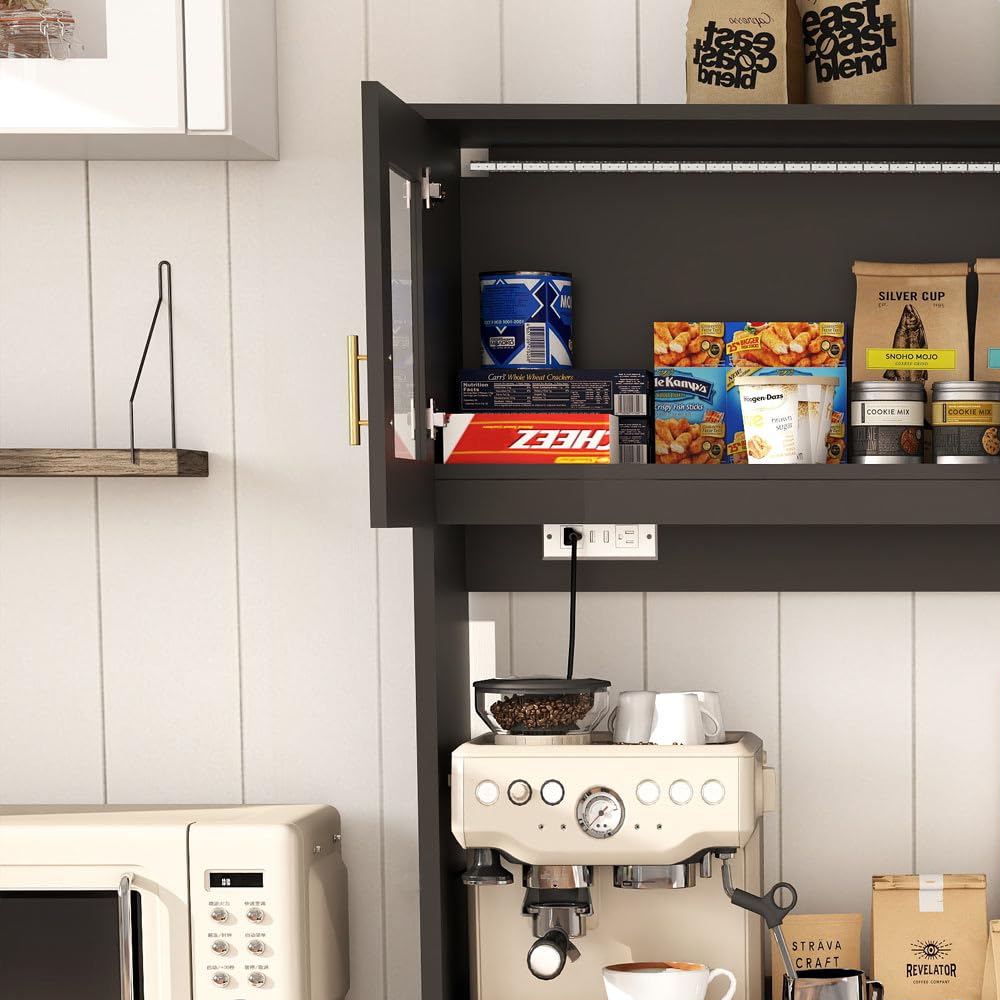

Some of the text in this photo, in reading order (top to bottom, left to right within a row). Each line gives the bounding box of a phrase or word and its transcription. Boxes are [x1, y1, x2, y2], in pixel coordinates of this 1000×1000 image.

[802, 0, 880, 37] east
[815, 45, 887, 83] blend
[878, 291, 946, 301] SILVER CUP
[546, 373, 574, 381] Crackers
[792, 940, 842, 951] STRÄVA
[796, 957, 839, 969] CRAFT
[906, 963, 957, 978] REVELATOR
